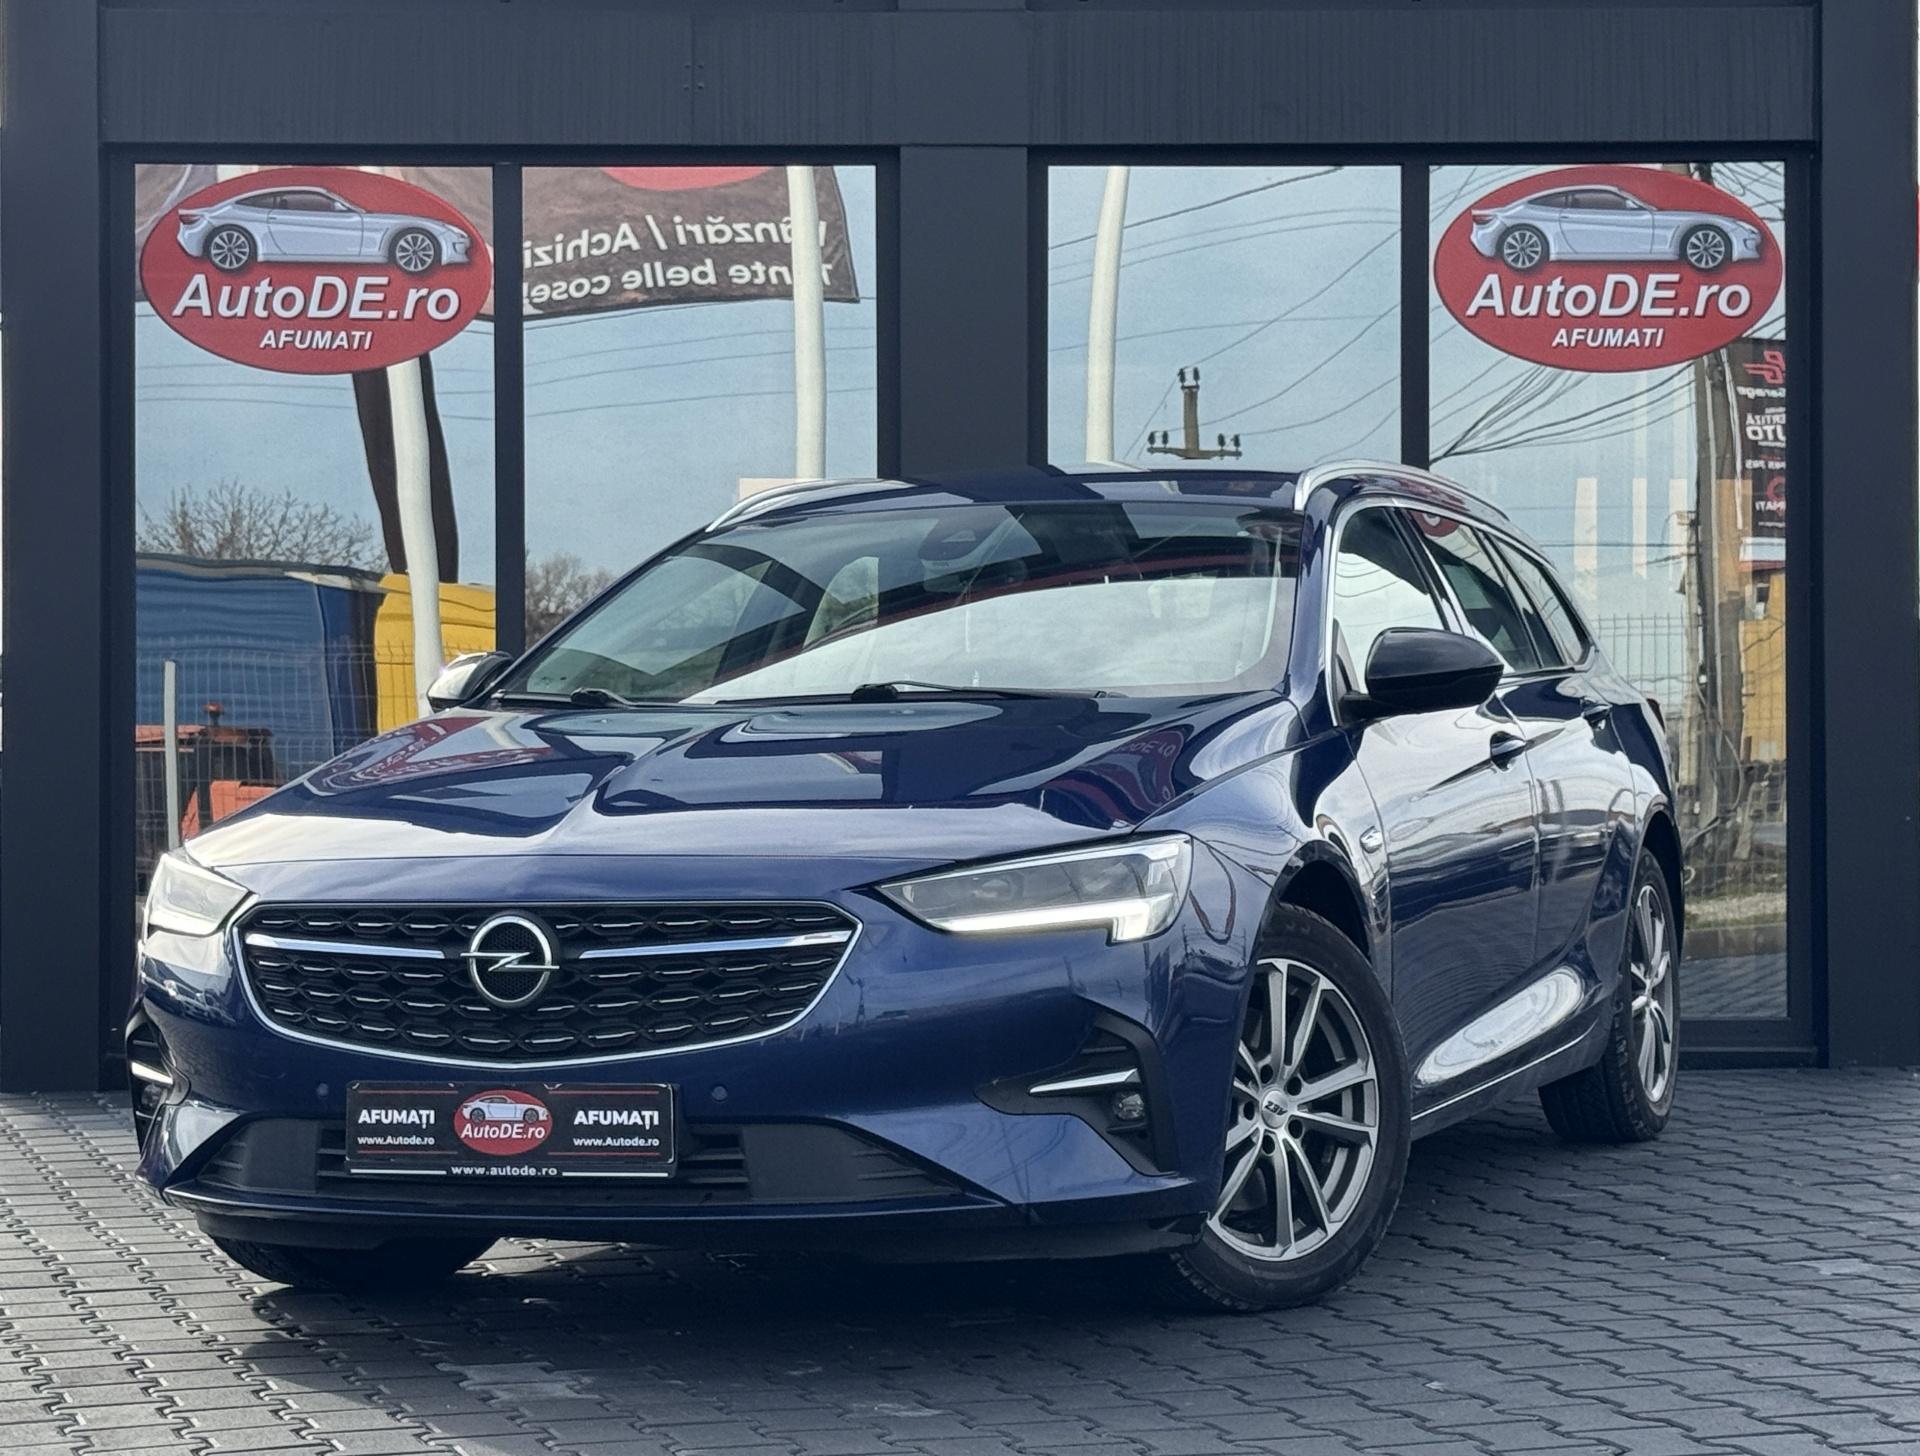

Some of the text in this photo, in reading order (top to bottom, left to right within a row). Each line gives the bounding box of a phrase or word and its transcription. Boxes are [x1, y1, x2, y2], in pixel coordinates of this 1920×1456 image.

[171, 273, 461, 321] AutoDE.ro
[1466, 273, 1751, 318] AutoDE.ro
[259, 329, 373, 350] AFUMATI
[1551, 328, 1664, 348] AFUMATI
[357, 1135, 435, 1145] www.Autode.ro
[460, 1123, 546, 1139] AutoDE.ro
[573, 1136, 660, 1147] www.Autode.ro
[451, 1165, 558, 1176] www.autode.ro
